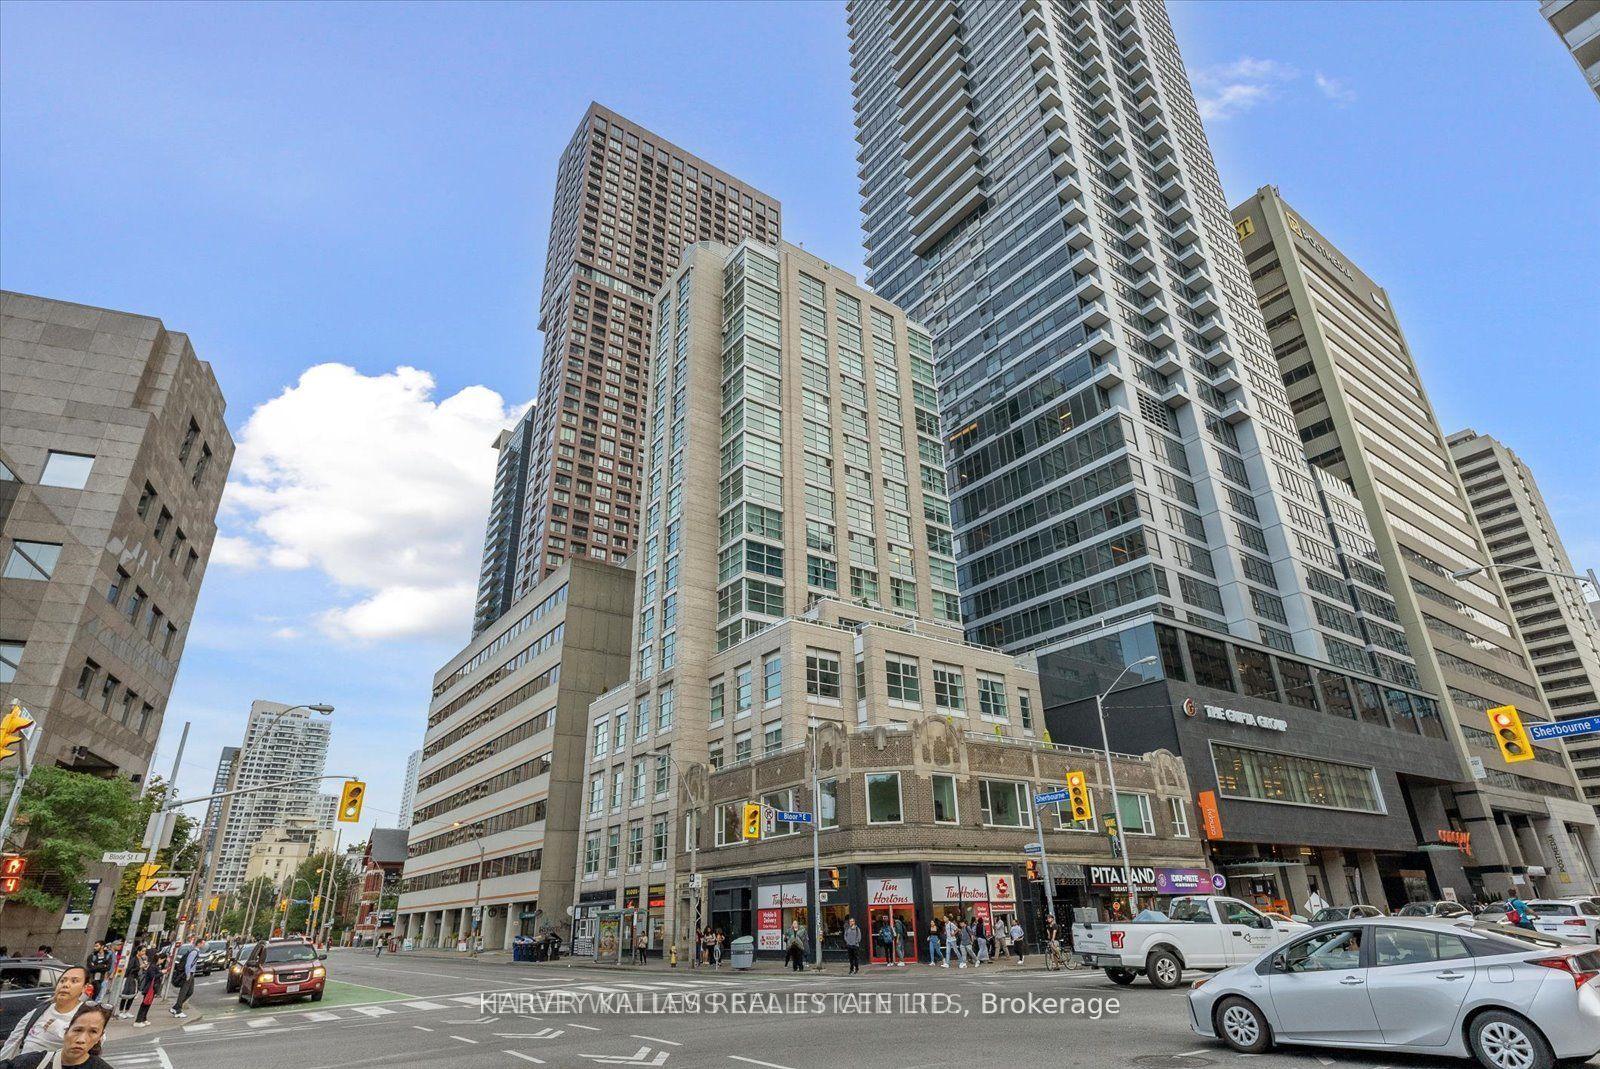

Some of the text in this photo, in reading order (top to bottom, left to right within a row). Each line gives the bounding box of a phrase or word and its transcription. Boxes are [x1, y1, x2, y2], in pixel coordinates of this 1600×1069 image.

[1533, 721, 1592, 738] Sherbourne
[1035, 793, 1066, 803] Sherbourne
[108, 853, 126, 861] Bloor
[1091, 867, 1156, 885] PITA LAND
[6, 879, 15, 892] 4
[881, 880, 898, 891] Tim
[945, 885, 989, 899] Tim Hortons
[782, 893, 804, 905] Hortons
[872, 891, 909, 904] Hortons
